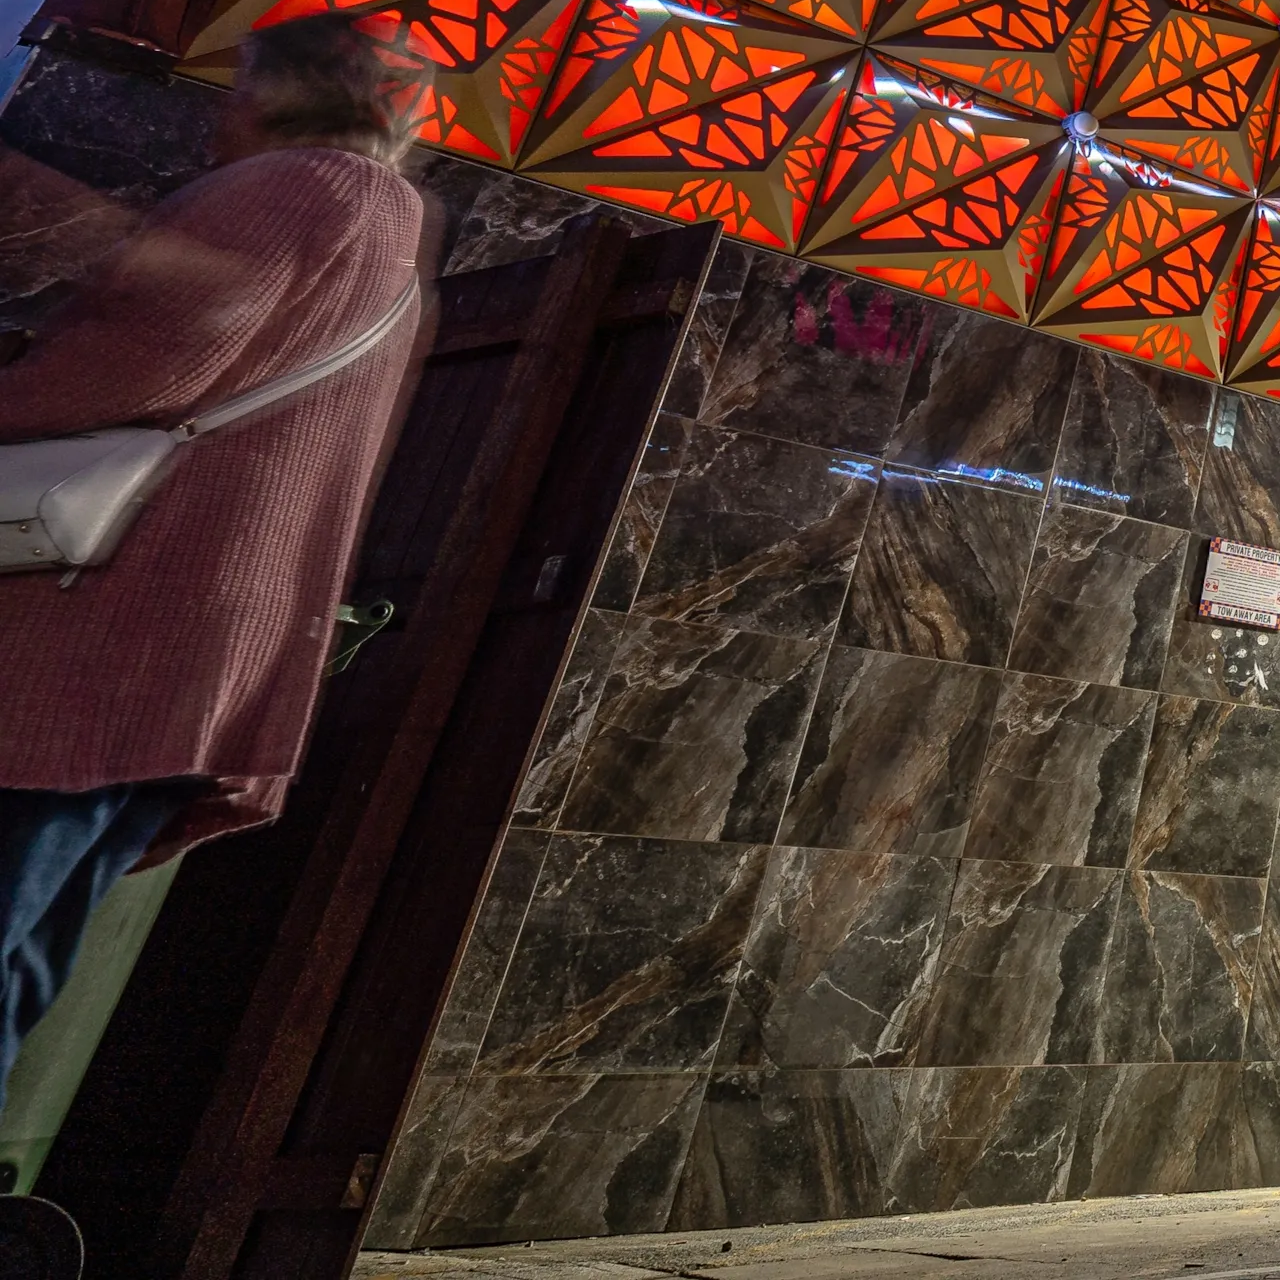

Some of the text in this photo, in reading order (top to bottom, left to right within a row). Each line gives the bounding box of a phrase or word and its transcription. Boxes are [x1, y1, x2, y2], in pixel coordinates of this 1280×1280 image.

[1226, 543, 1251, 556] PRIVATE
[1217, 606, 1271, 624] TOW AWAY AREA
